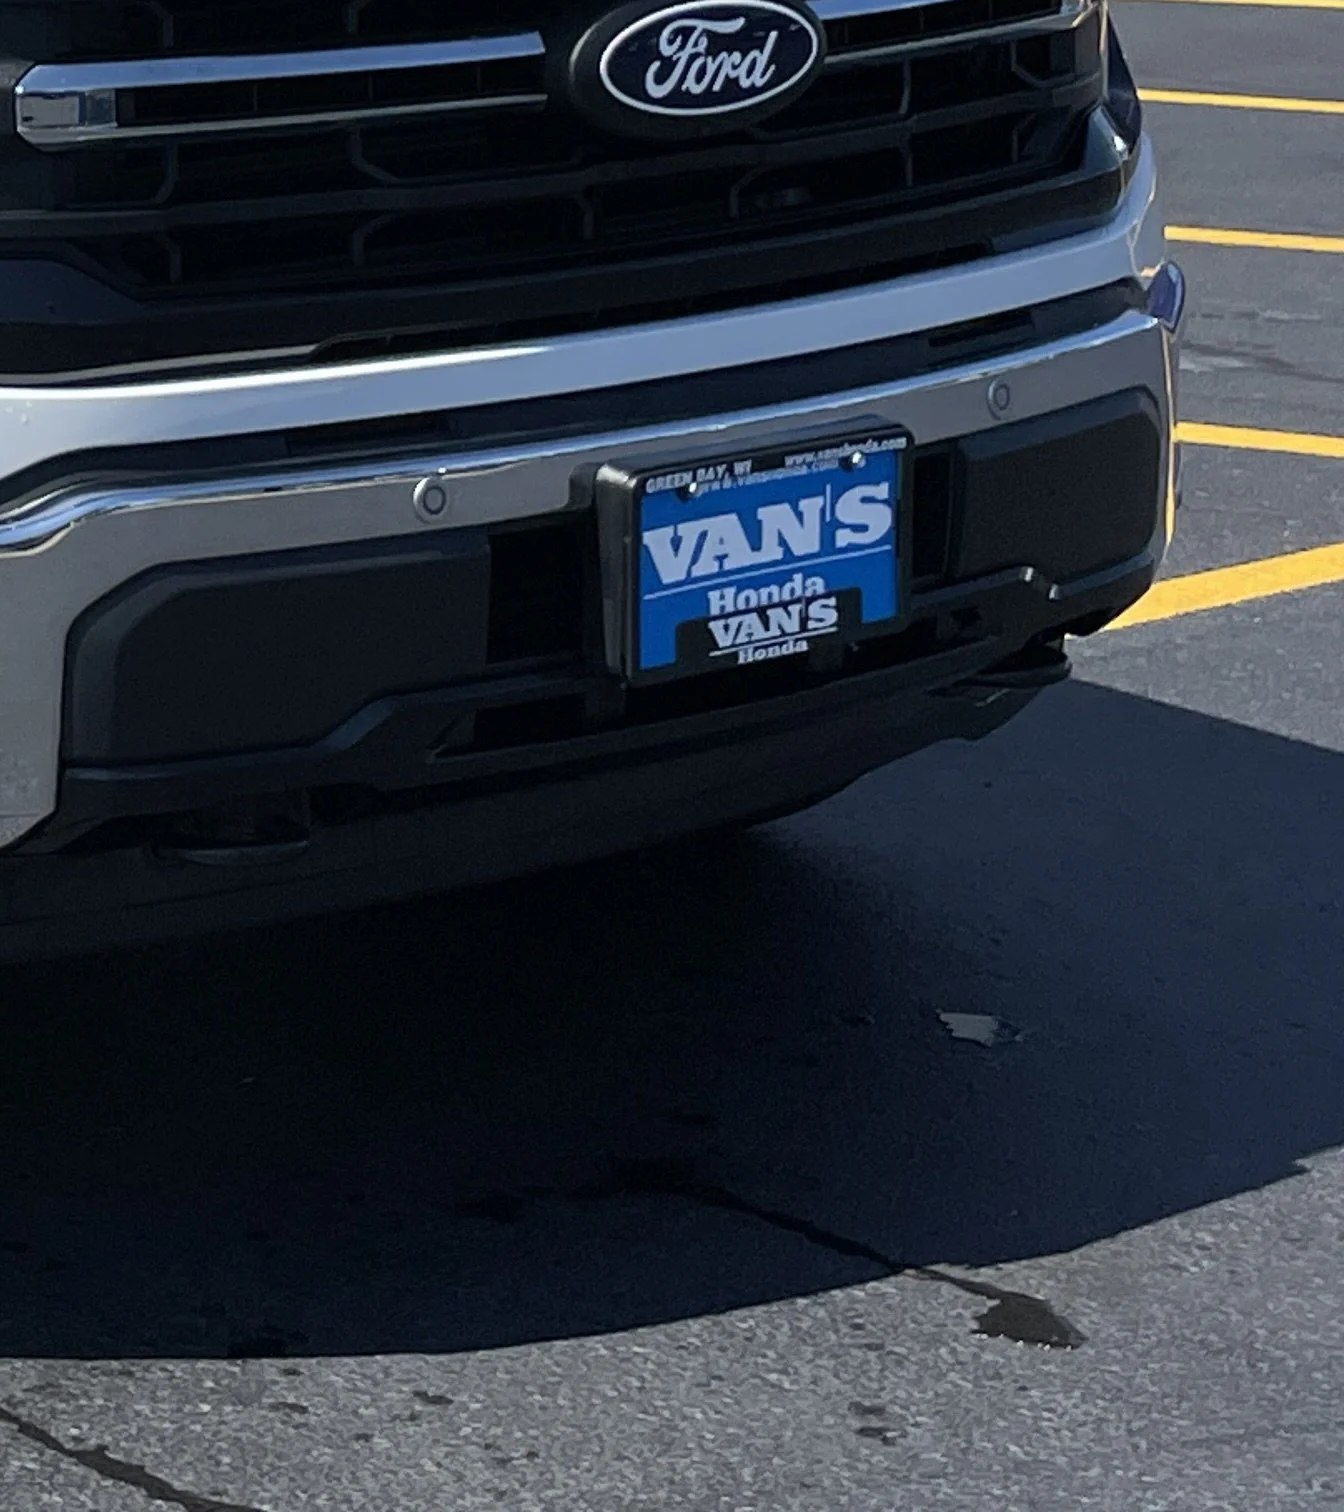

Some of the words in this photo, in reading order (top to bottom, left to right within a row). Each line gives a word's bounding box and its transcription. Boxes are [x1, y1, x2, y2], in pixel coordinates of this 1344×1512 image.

[644, 16, 779, 99] Ford
[646, 471, 693, 494] GREEN
[733, 459, 753, 476] WI
[642, 482, 893, 586] VAN'S
[708, 573, 825, 616] Honda
[708, 596, 839, 649] VAN'S
[736, 639, 809, 665] Honda
